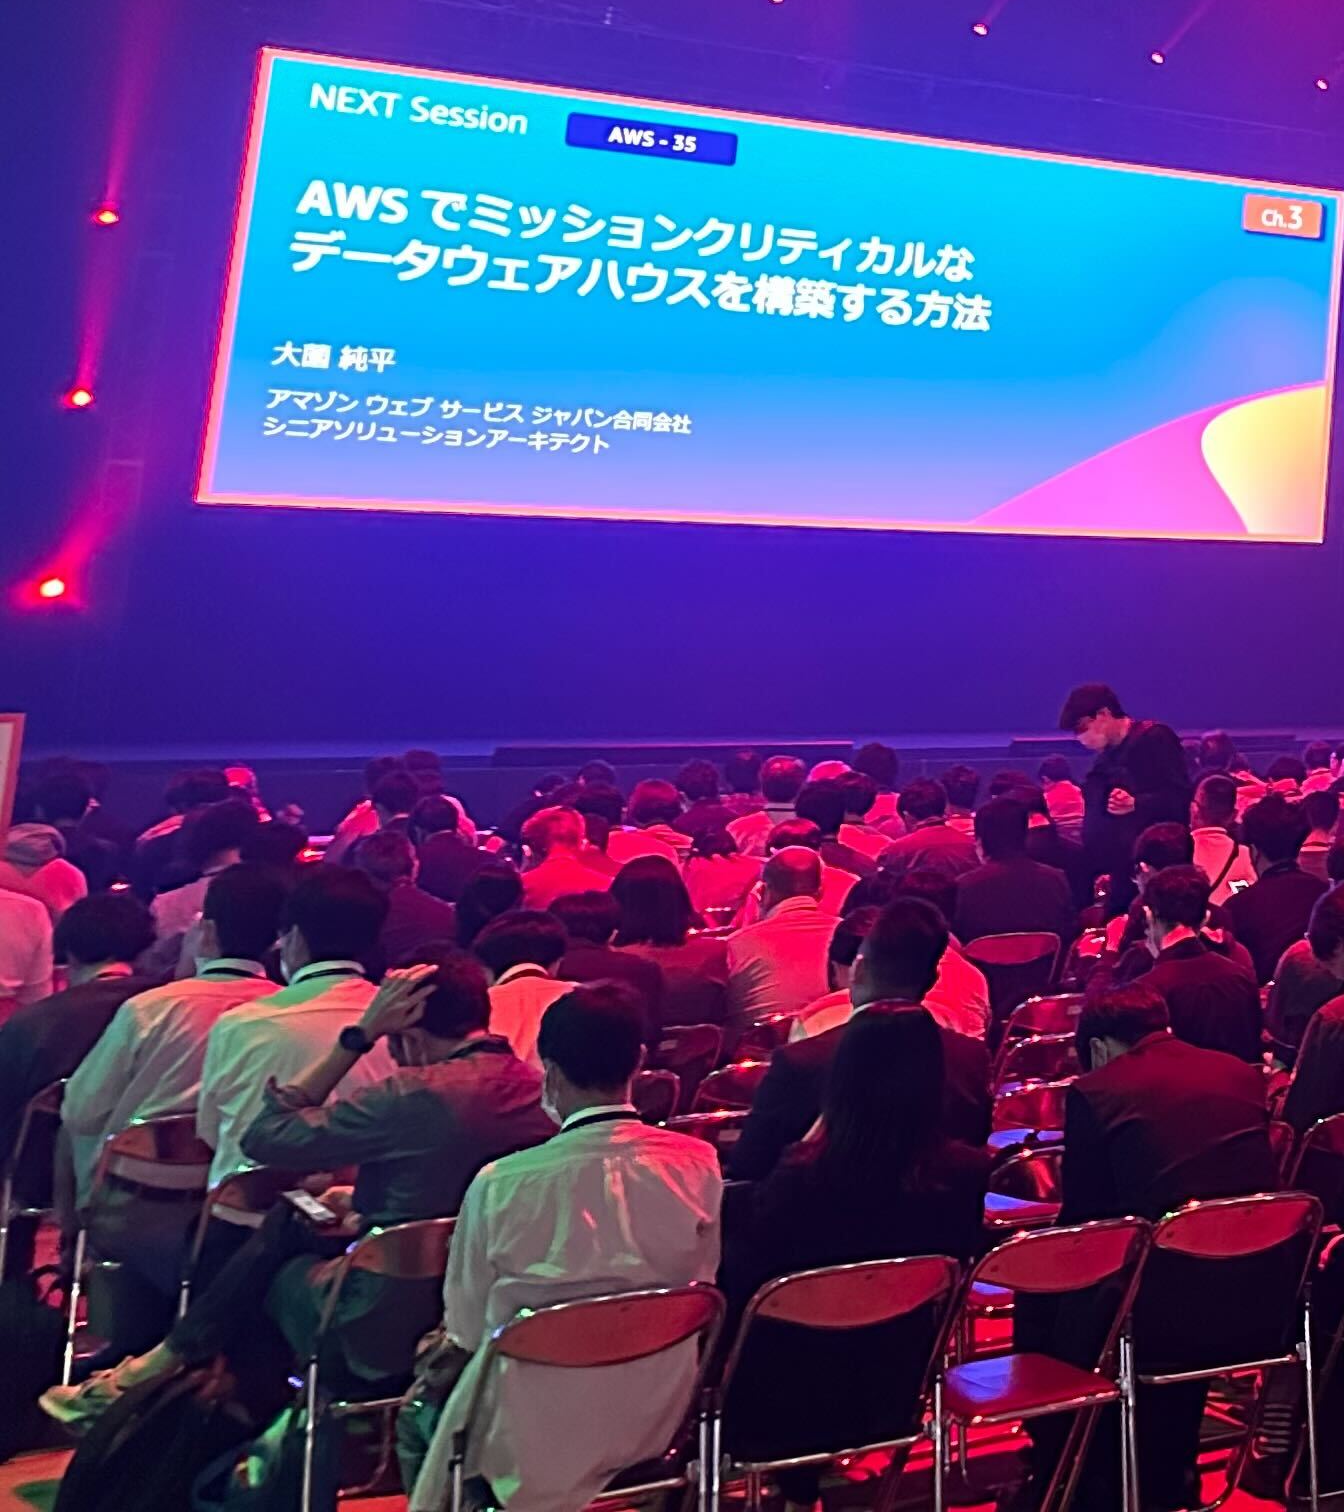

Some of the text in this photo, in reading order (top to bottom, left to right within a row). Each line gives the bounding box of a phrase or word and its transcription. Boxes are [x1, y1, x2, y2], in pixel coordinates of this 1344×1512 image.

[309, 82, 529, 135] NEXT Session
[608, 125, 655, 148] AWS
[672, 132, 697, 153] 35
[295, 179, 974, 283] AWS でミッションクリティカルな
[1260, 205, 1303, 231] Ch.3
[290, 228, 993, 333] データウェアハウスを構築する方法
[338, 344, 397, 373] 純平
[265, 387, 693, 435] アマゾン ウェブ サービス ジャパン合同会社
[262, 414, 610, 455] シニアソリューションアーキテクト
